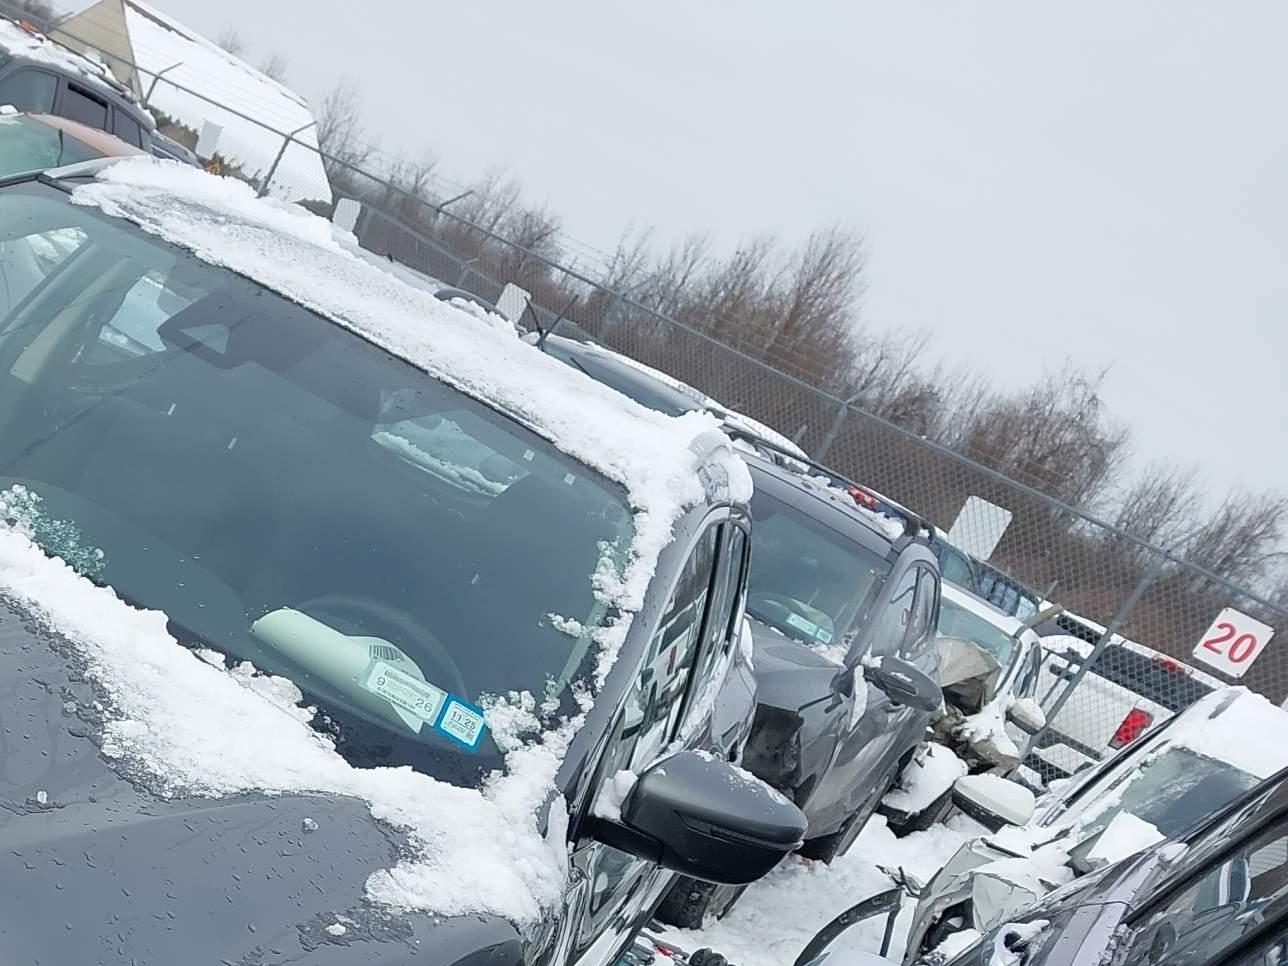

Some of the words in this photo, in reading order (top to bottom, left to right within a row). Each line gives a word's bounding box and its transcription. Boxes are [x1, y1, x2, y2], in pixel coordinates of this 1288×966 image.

[1202, 622, 1257, 663] 20
[376, 676, 386, 687] 9
[415, 698, 433, 713] 26
